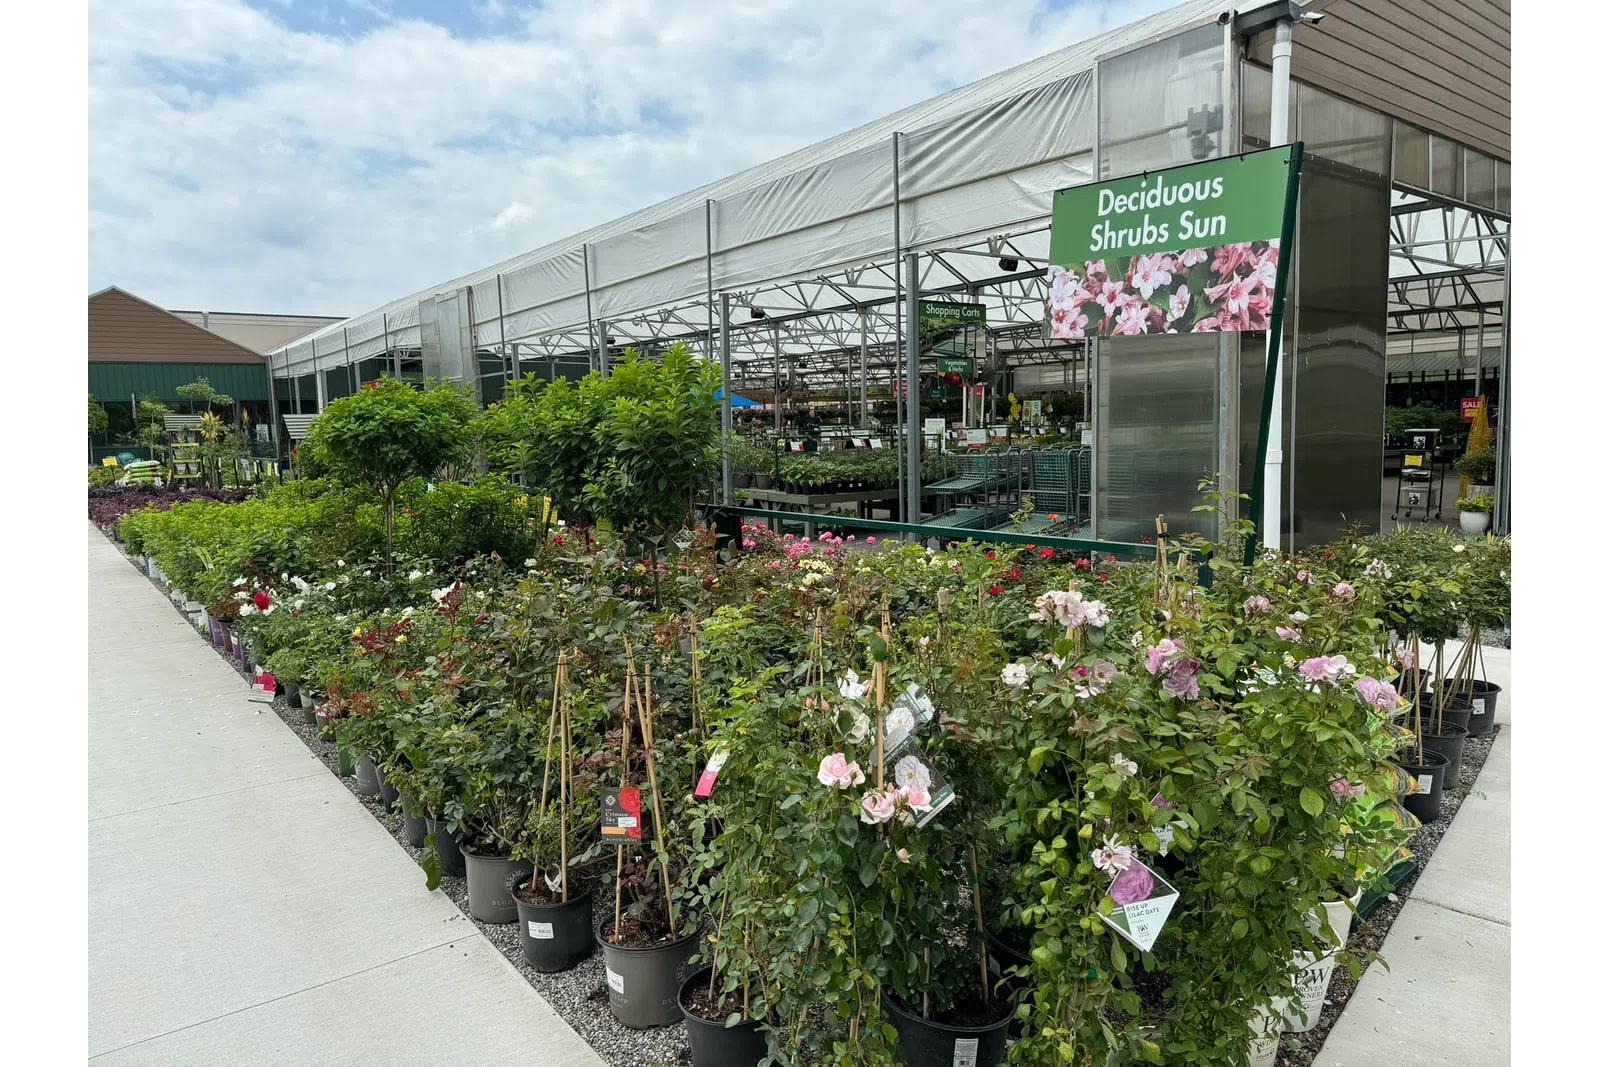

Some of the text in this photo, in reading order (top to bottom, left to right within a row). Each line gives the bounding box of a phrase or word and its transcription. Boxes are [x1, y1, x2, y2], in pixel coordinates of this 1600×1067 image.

[1098, 175, 1223, 217] Deciduous
[1090, 210, 1227, 252] Shrubs Sun
[926, 303, 981, 318] Shopping Carts
[1126, 904, 1140, 912] RISE
[1128, 907, 1160, 919] LILAC DAYS
